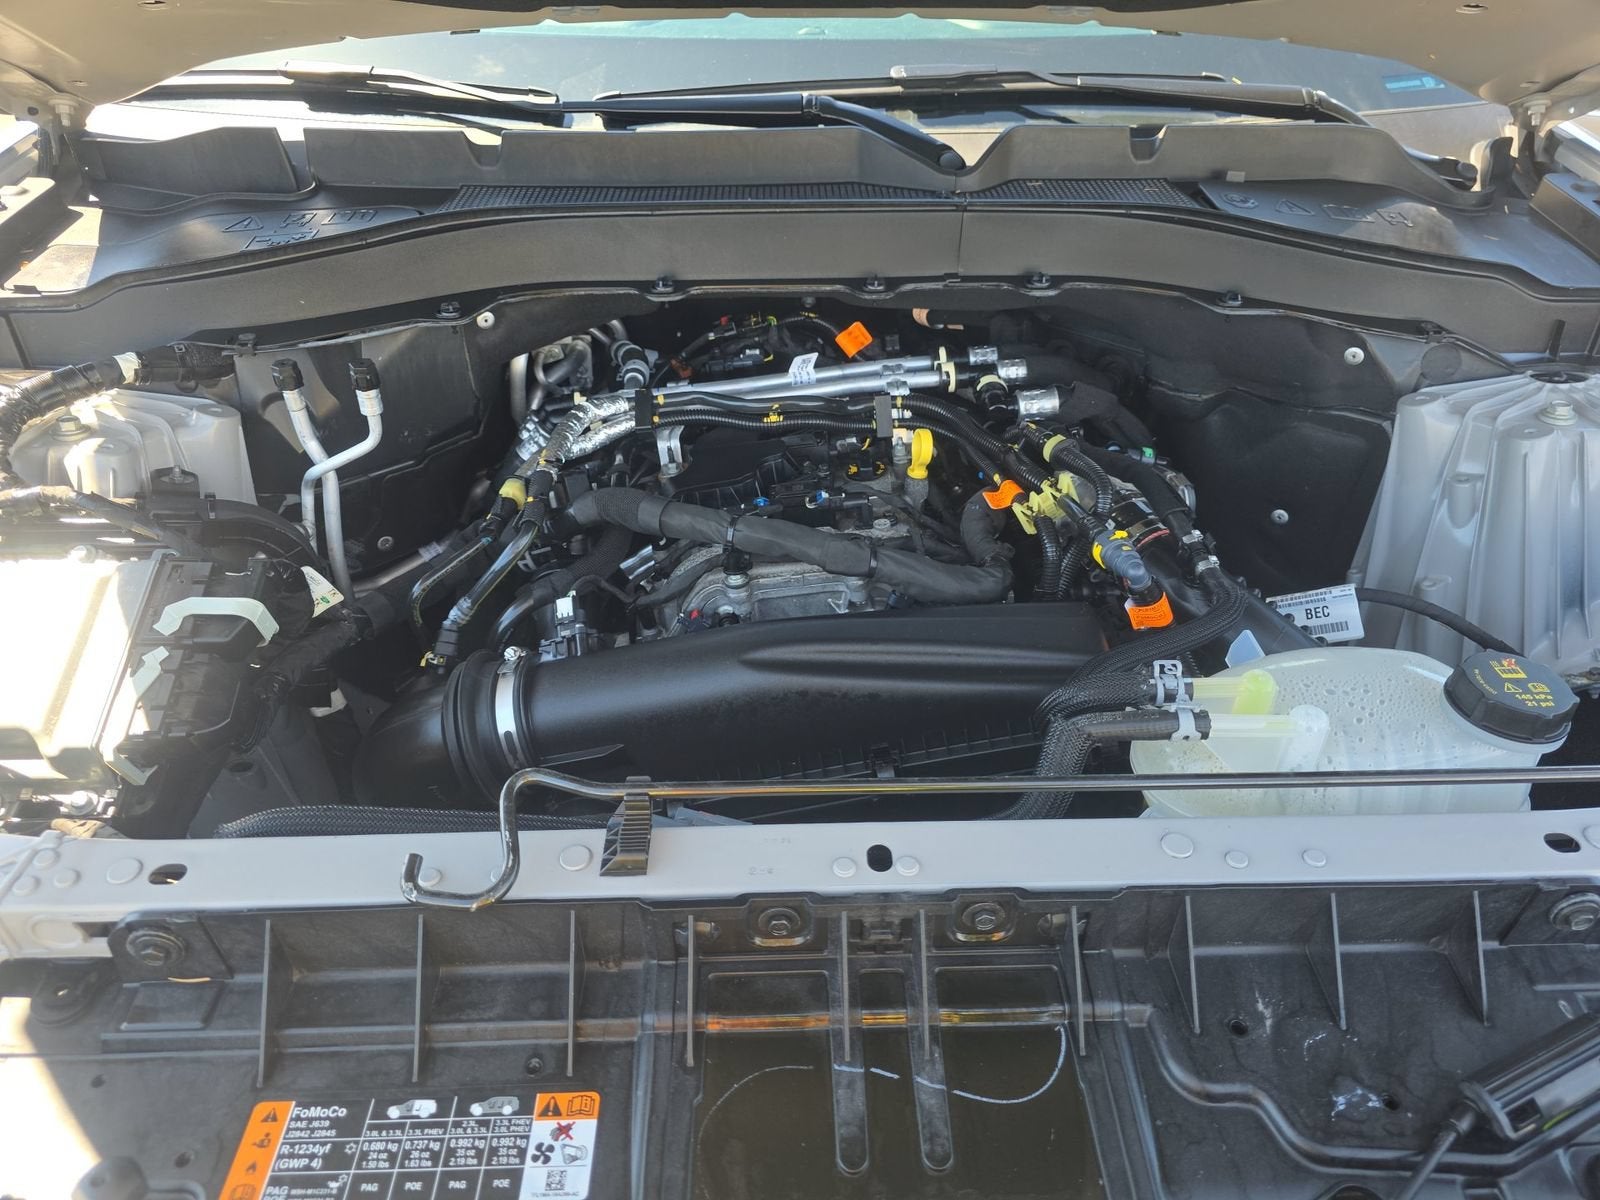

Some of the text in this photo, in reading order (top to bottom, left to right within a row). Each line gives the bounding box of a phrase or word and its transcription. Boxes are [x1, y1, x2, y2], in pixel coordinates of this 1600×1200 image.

[1305, 605, 1330, 620] BEC
[292, 1106, 347, 1119] FoMoCo
[289, 1120, 330, 1128] SAE J639
[511, 1118, 532, 1126] FHEV
[362, 1141, 399, 1152] 0.680 kg
[405, 1140, 441, 1151] 0.737 kg
[449, 1138, 486, 1149] 0.992 kg
[491, 1136, 528, 1148] 0.992 kg
[280, 1143, 332, 1156] R-1234yf
[456, 1148, 466, 1156] 35
[497, 1147, 508, 1155] 35
[368, 1151, 378, 1159] 24
[274, 1157, 322, 1171] (GWP 4)
[362, 1160, 390, 1168] 1.50 lbs
[404, 1159, 432, 1167] 1.63 lbs
[448, 1157, 478, 1166] 2.19 lbs
[491, 1156, 520, 1165] 2.19 lbs
[360, 1183, 379, 1191] PAG
[404, 1181, 423, 1190] POE
[448, 1180, 467, 1189] PAG
[492, 1179, 511, 1188] POE
[265, 1186, 289, 1195] PAG
